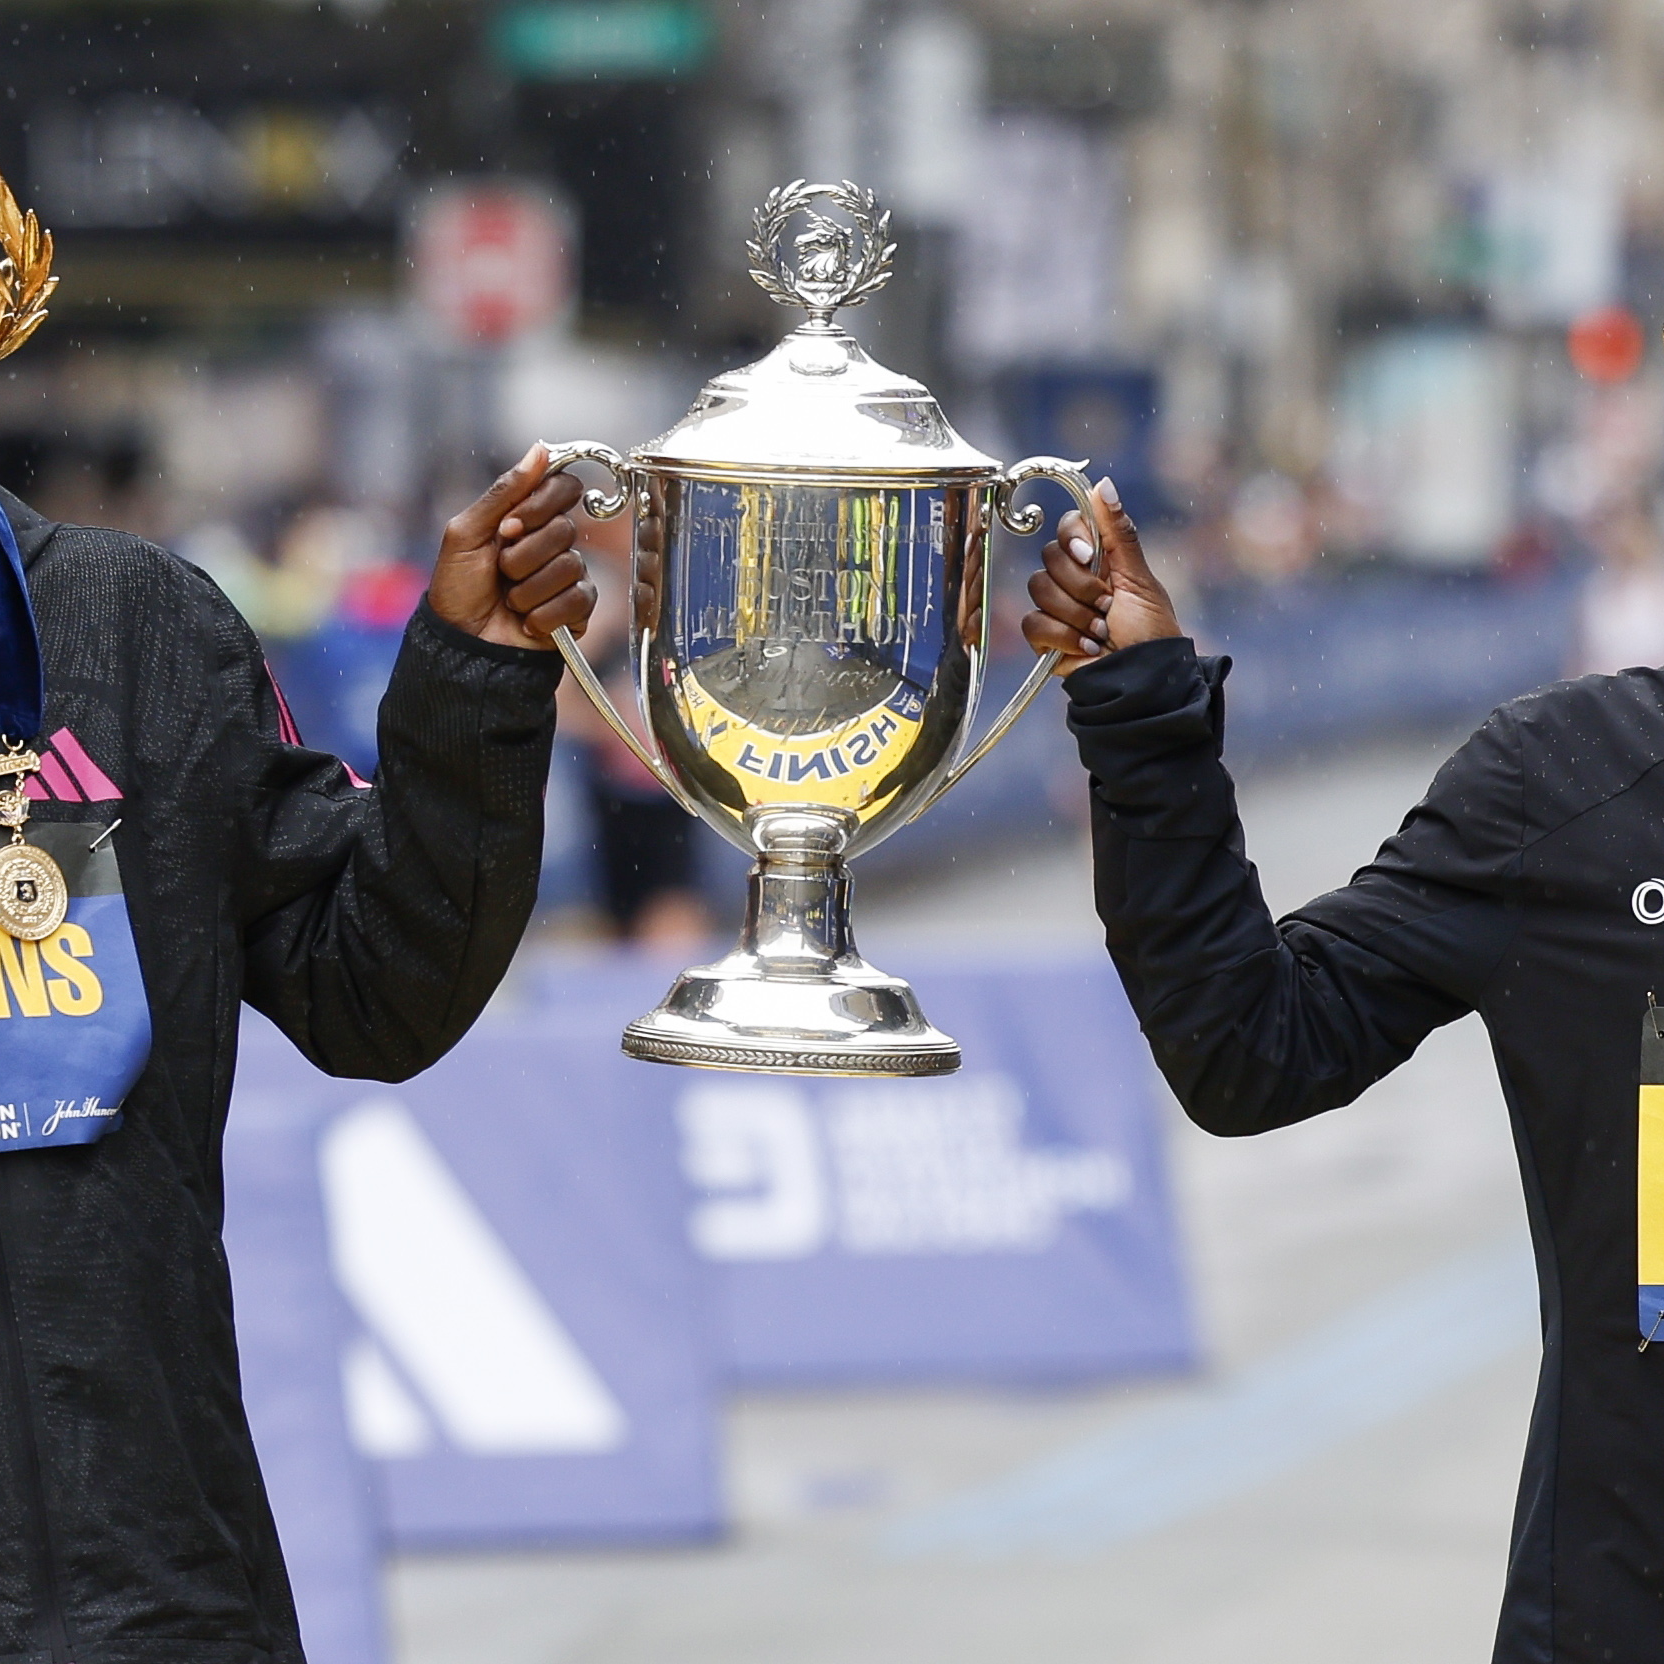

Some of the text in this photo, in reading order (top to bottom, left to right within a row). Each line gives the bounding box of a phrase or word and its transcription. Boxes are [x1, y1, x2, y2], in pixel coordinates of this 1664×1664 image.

[672, 514, 737, 541] BSTON
[736, 567, 886, 605] BOSTON
[41, 1099, 82, 1136] John
